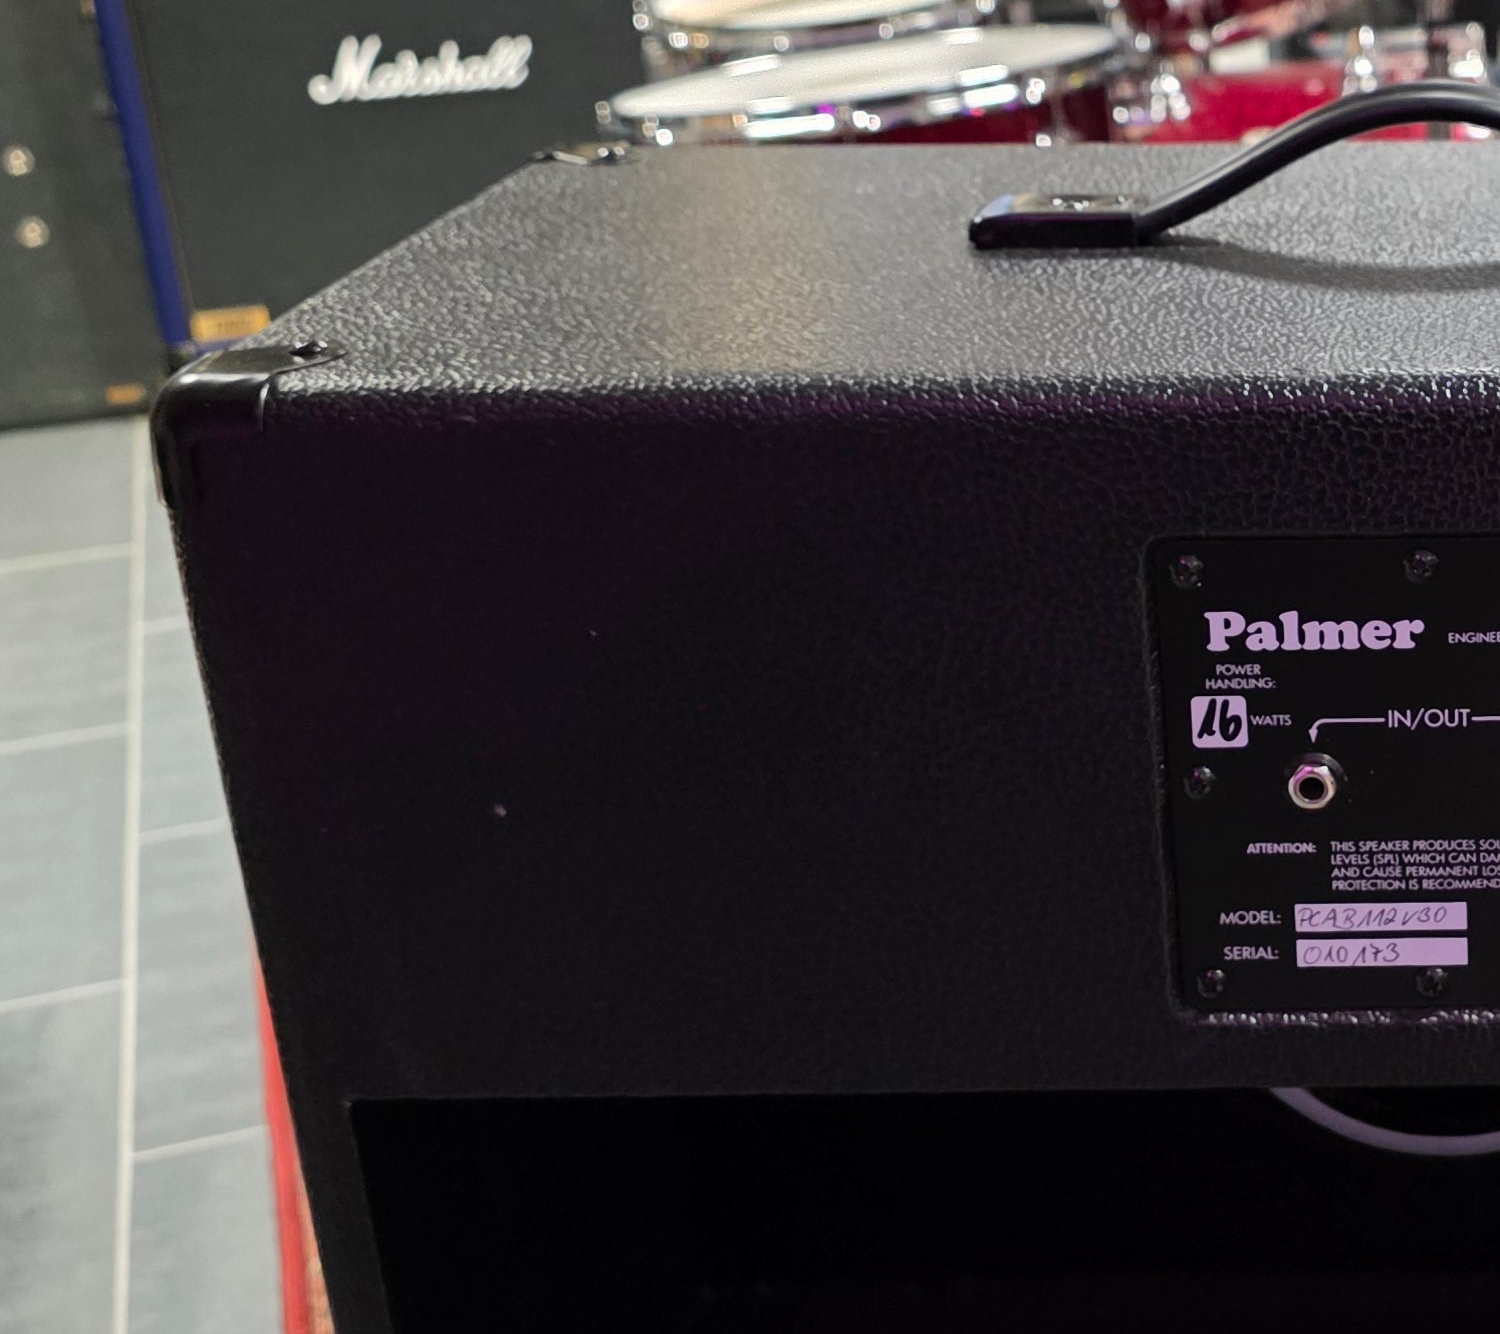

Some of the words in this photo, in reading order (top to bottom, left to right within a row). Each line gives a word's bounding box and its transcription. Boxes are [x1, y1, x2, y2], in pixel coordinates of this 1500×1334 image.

[307, 33, 533, 105] Marshall
[1203, 610, 1425, 652] Palmer
[1215, 663, 1261, 676] POWER
[1205, 677, 1277, 689] HANDLING:
[1250, 714, 1292, 726] WATTS
[1388, 708, 1471, 731] IN/OUT
[1246, 842, 1317, 854] ATTENTION:
[1330, 841, 1356, 852] THIS
[1359, 840, 1410, 852] SPEAKER
[1412, 839, 1477, 851] PRODUCES
[1330, 853, 1370, 865] LEVELS
[1373, 853, 1400, 866] (SPL)
[1402, 853, 1446, 864] WHICH
[1448, 852, 1477, 863] CAN
[1331, 866, 1360, 878] AND
[1362, 866, 1403, 878] CAUSE
[1405, 865, 1479, 877] PERMANENT
[1331, 879, 1406, 891] PROTECTION
[1408, 879, 1419, 890] IS
[1219, 910, 1282, 925] MODEL:
[1223, 945, 1280, 961] SERIAL:
